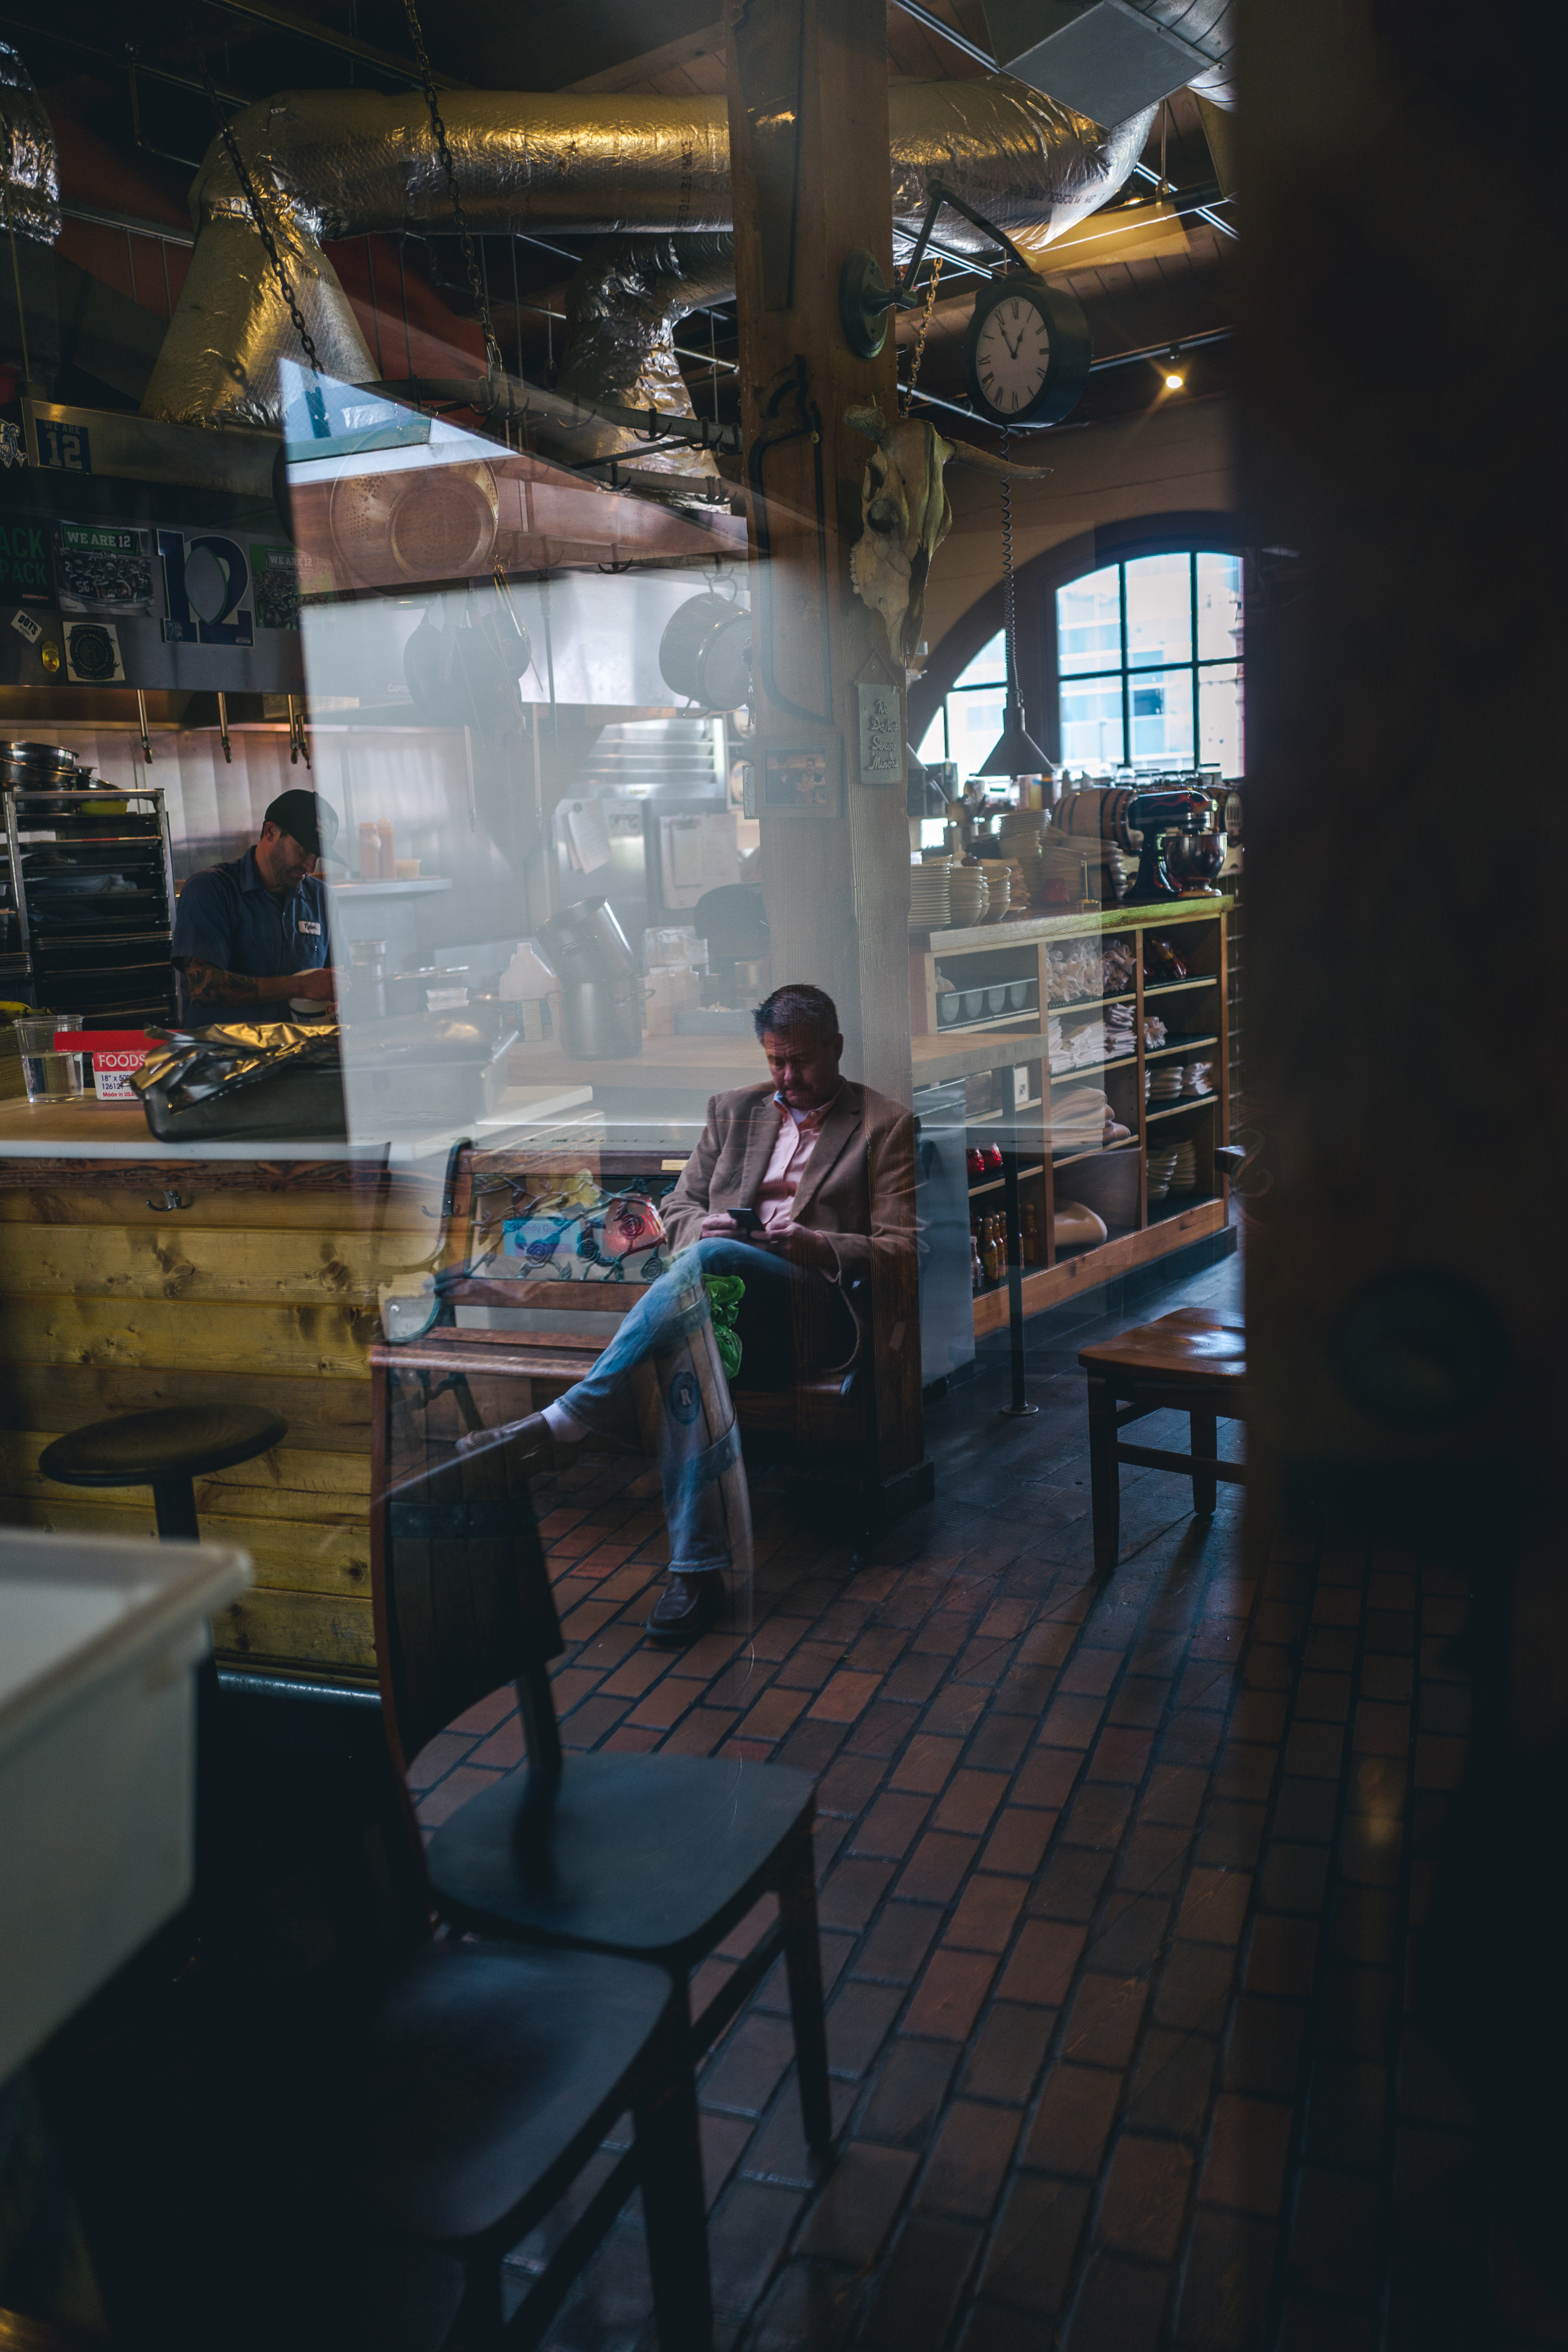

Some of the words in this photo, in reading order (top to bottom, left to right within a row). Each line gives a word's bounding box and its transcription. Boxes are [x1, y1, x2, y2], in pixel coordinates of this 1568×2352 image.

[45, 421, 60, 431] WE
[62, 425, 80, 435] ARE
[46, 432, 83, 470] 12
[66, 531, 88, 544] WE
[90, 533, 117, 548] ARE
[118, 535, 131, 548] 12
[270, 555, 284, 564] WE
[18, 615, 38, 635] DOTS
[871, 735, 896, 751] Serve
[867, 755, 899, 770] Minors
[99, 1054, 146, 1067] FOODS
[680, 1388, 692, 1406] R
